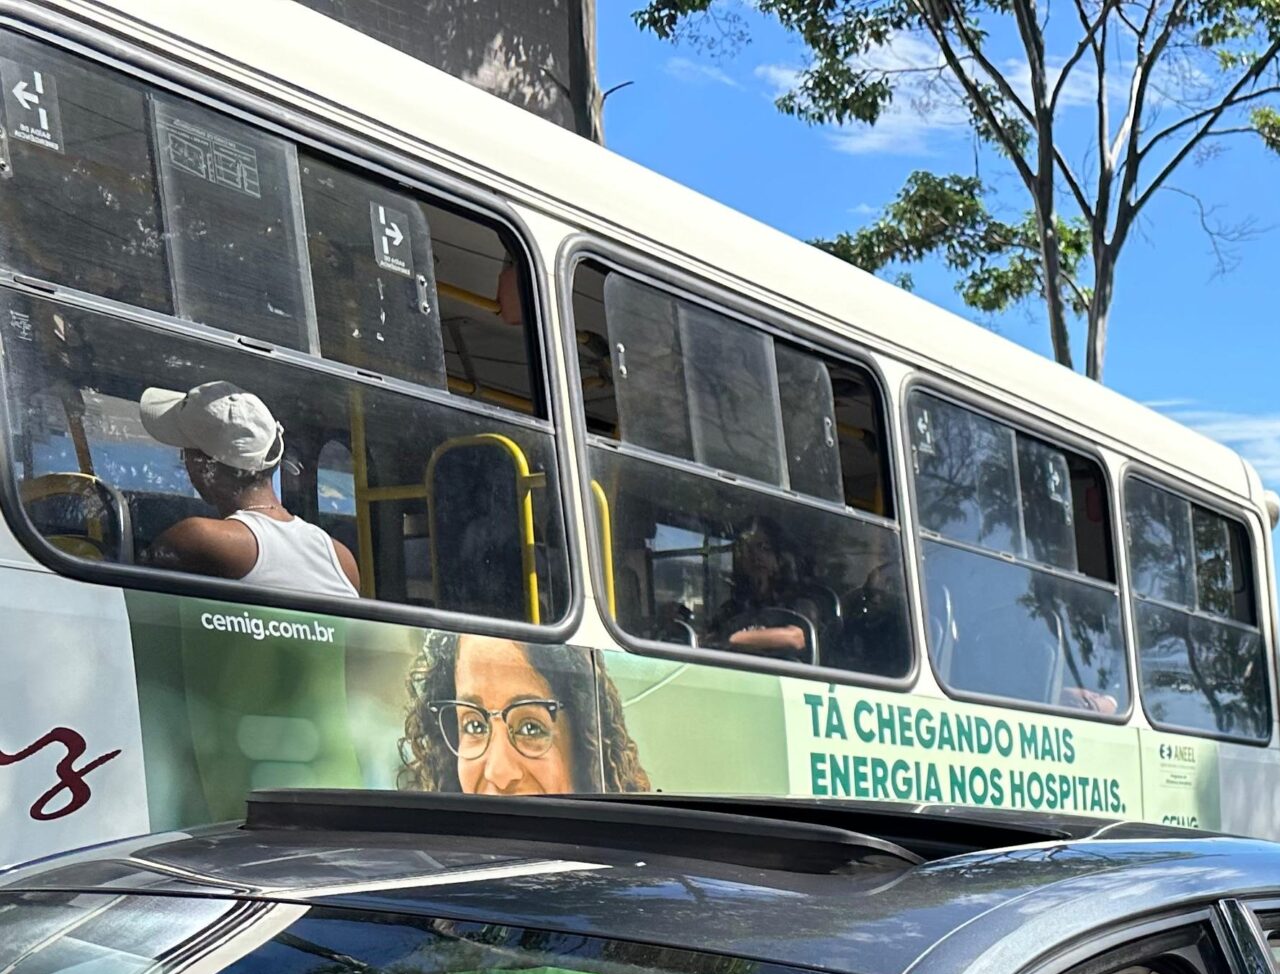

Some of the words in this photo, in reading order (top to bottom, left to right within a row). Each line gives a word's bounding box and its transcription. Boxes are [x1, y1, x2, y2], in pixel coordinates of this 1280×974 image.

[201, 611, 335, 643] cemig.com.br
[803, 683, 848, 740] TÁ
[854, 700, 1013, 757] CHEGANDO
[1018, 722, 1075, 764] MAIS
[1174, 745, 1196, 763] ANEEL
[810, 752, 943, 803] ENERGIA
[949, 764, 1004, 806] NOS
[1009, 770, 1126, 814] HOSPITAIS.
